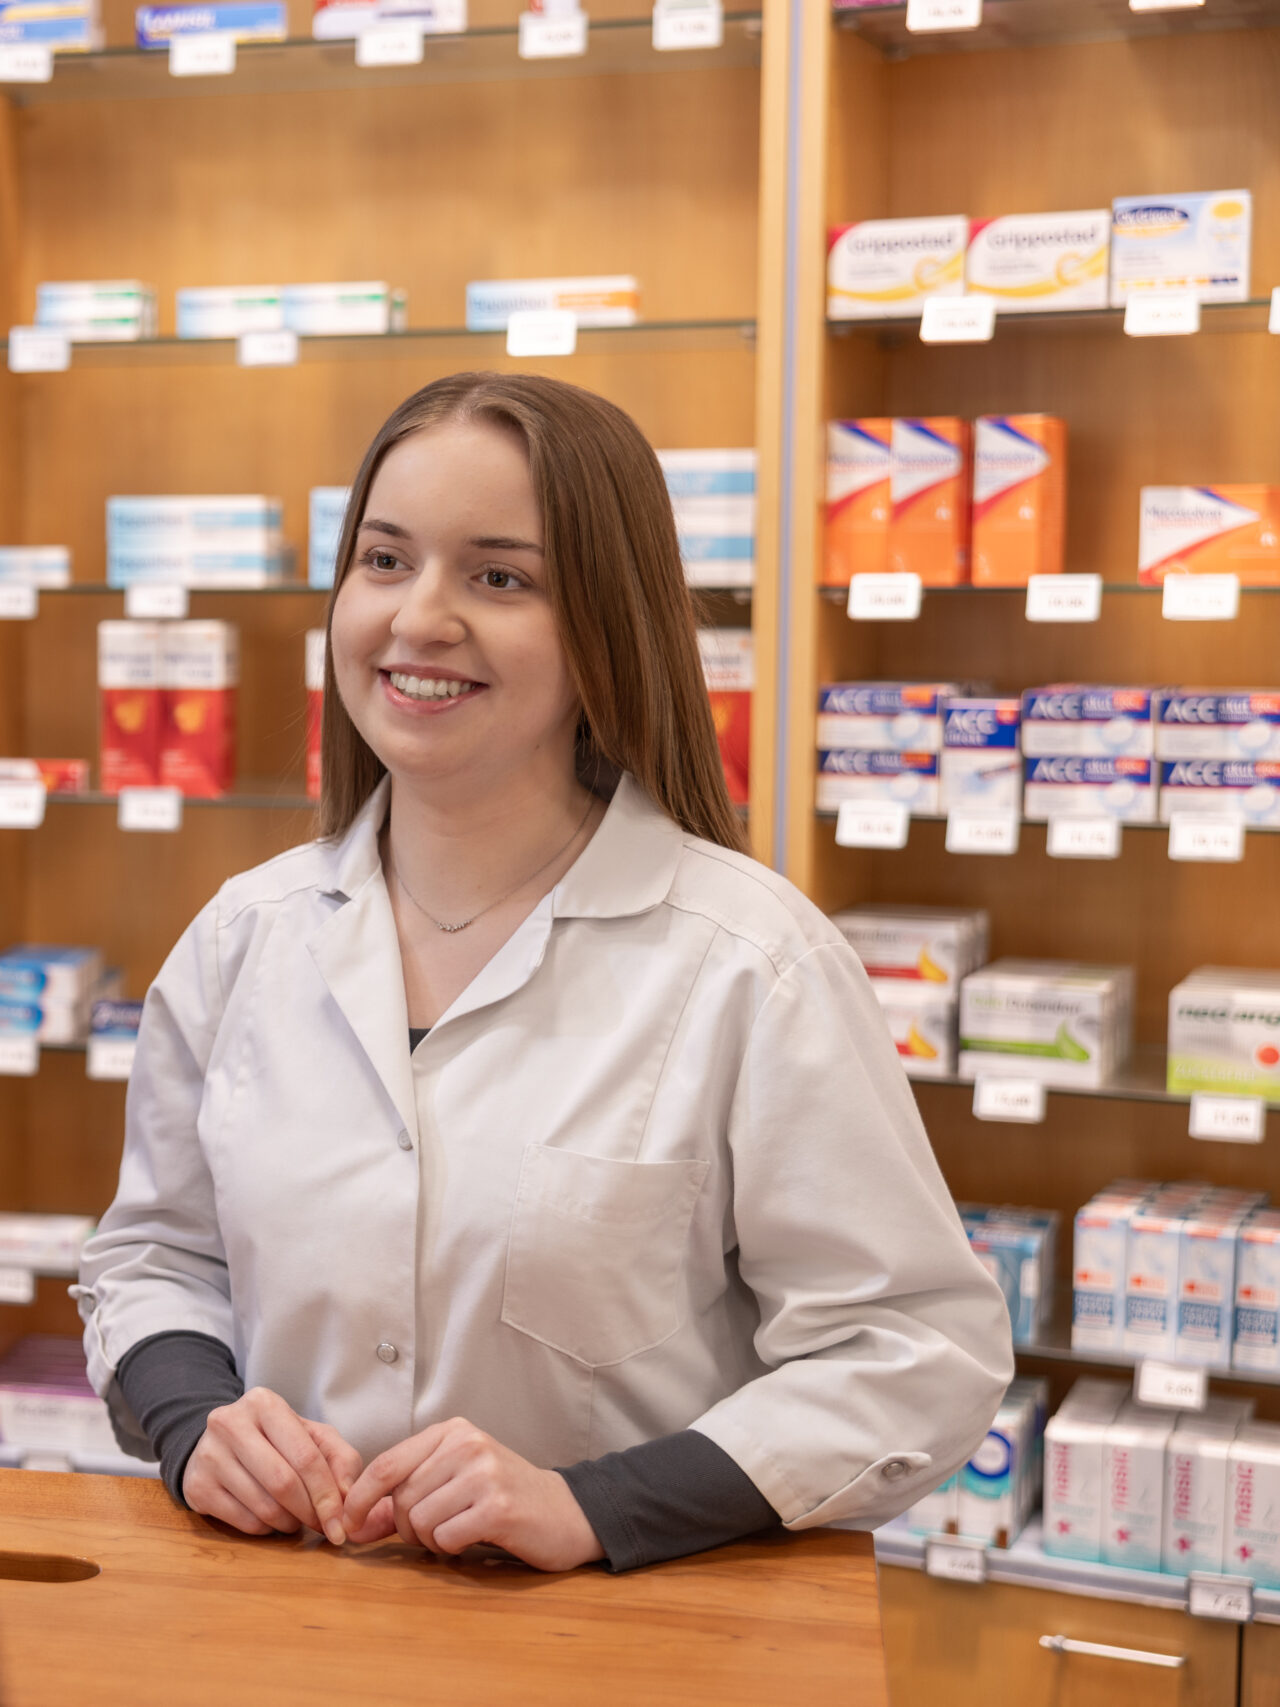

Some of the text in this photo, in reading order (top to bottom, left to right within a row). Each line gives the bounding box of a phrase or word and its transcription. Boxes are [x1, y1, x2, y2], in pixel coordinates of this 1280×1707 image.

[846, 231, 956, 256] Grippostad
[986, 224, 1098, 251] Grippostad
[824, 688, 872, 712] ACC
[1030, 694, 1083, 720] ACC
[1164, 697, 1219, 723] ACC
[946, 710, 999, 735] ACC
[823, 751, 871, 774] ACC
[1032, 758, 1085, 782] ACC
[1168, 761, 1221, 786] ACC
